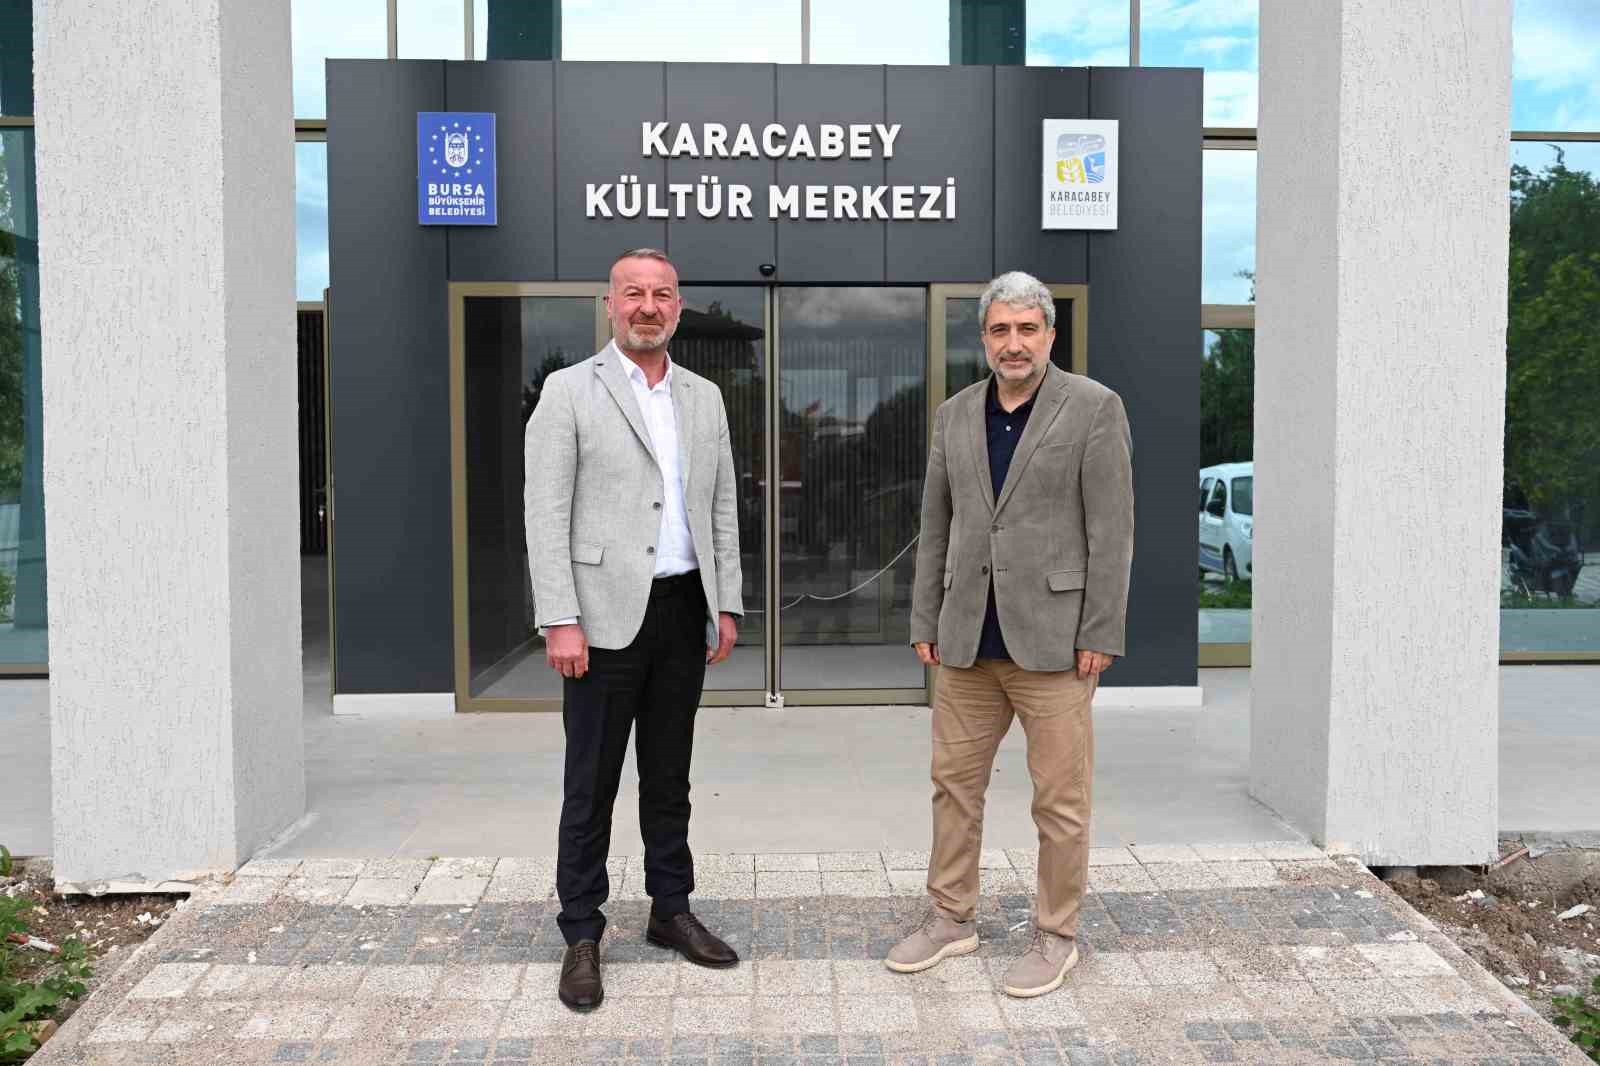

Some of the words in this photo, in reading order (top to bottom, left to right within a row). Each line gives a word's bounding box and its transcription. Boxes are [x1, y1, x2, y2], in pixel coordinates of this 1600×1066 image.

[642, 122, 901, 158] KARACABEY
[428, 183, 485, 196] BURSA
[428, 195, 485, 207] BÜYÜKŞEHİR
[586, 175, 753, 218] KÜLTÜR
[769, 177, 956, 219] MERKEZİ
[1050, 191, 1111, 202] KARACABEY
[428, 206, 486, 216] BELEDİYESİ
